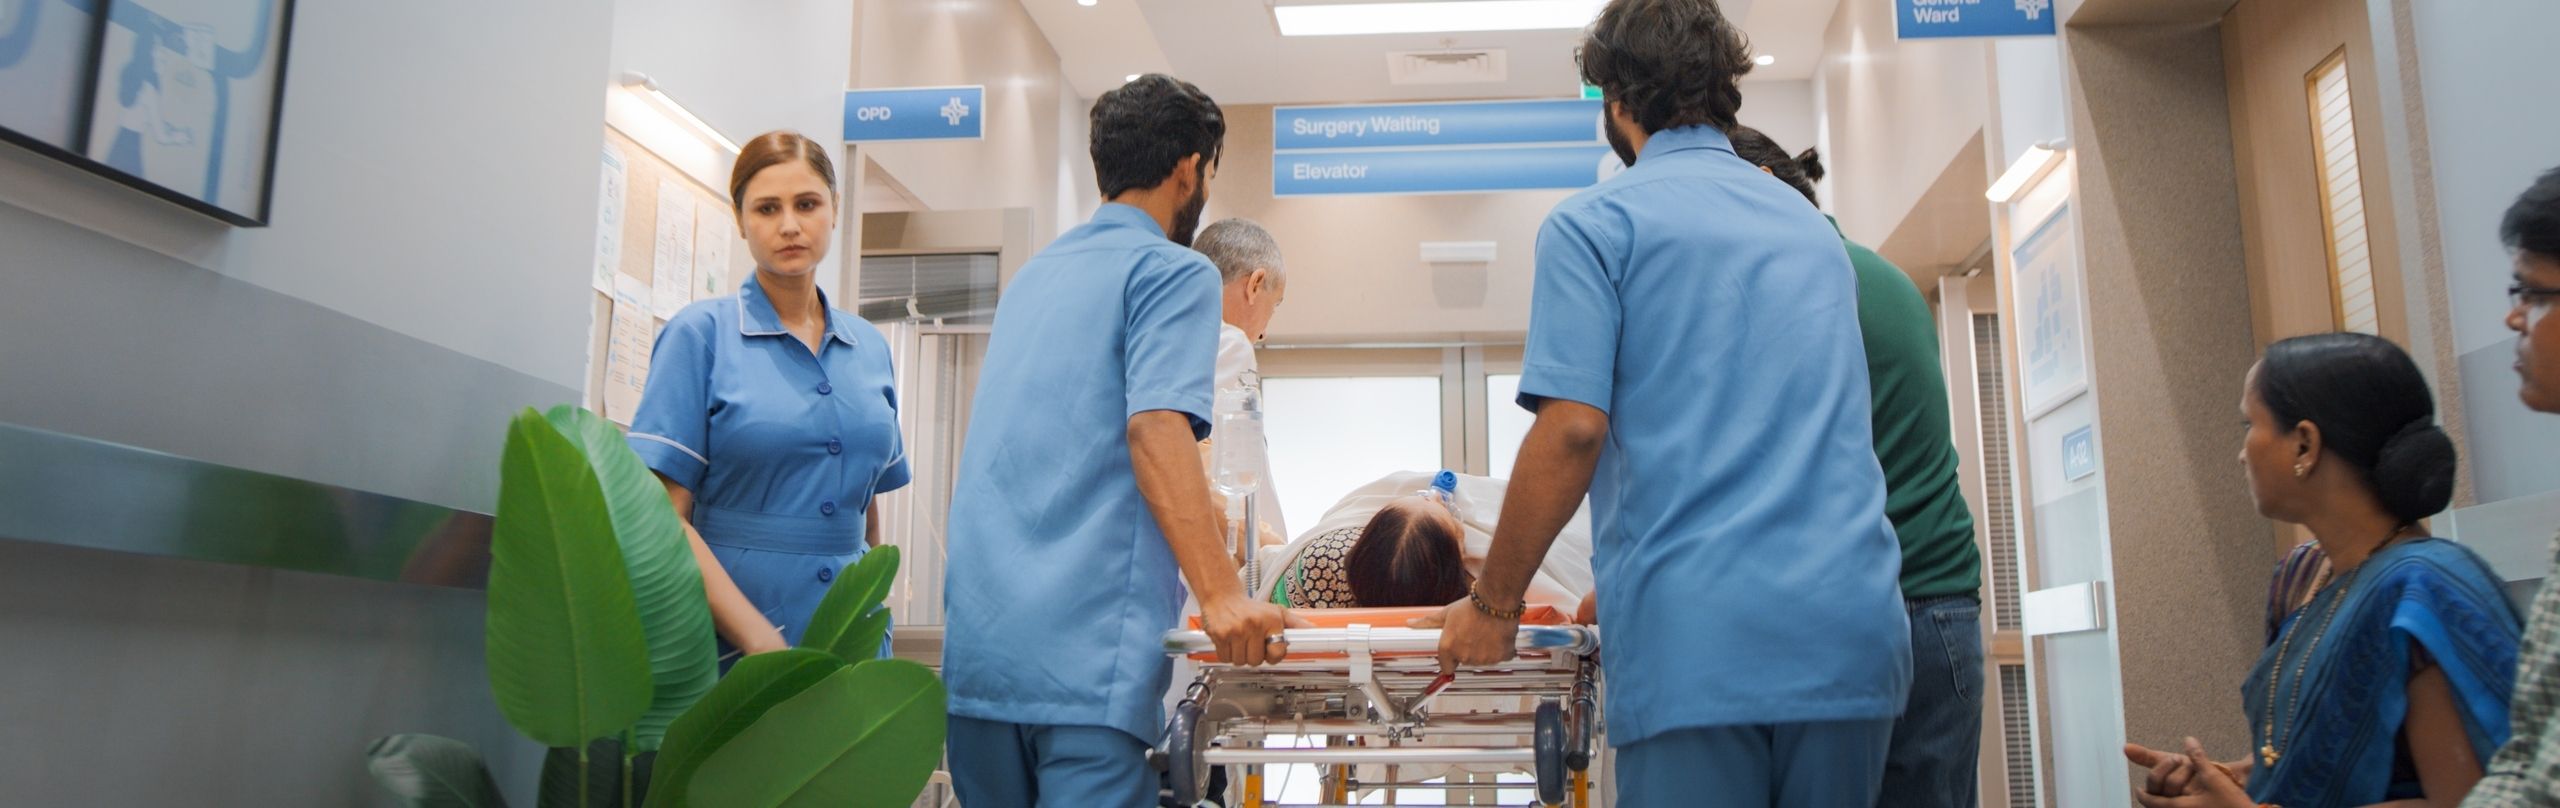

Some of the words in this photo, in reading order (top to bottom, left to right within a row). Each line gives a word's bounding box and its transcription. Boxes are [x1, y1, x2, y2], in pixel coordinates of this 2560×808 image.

[1913, 6, 1960, 24] Ward
[857, 106, 892, 121] OPD
[1293, 117, 1367, 138] Surgery
[1371, 115, 1440, 135] Waiting
[1293, 163, 1368, 180] Elevator
